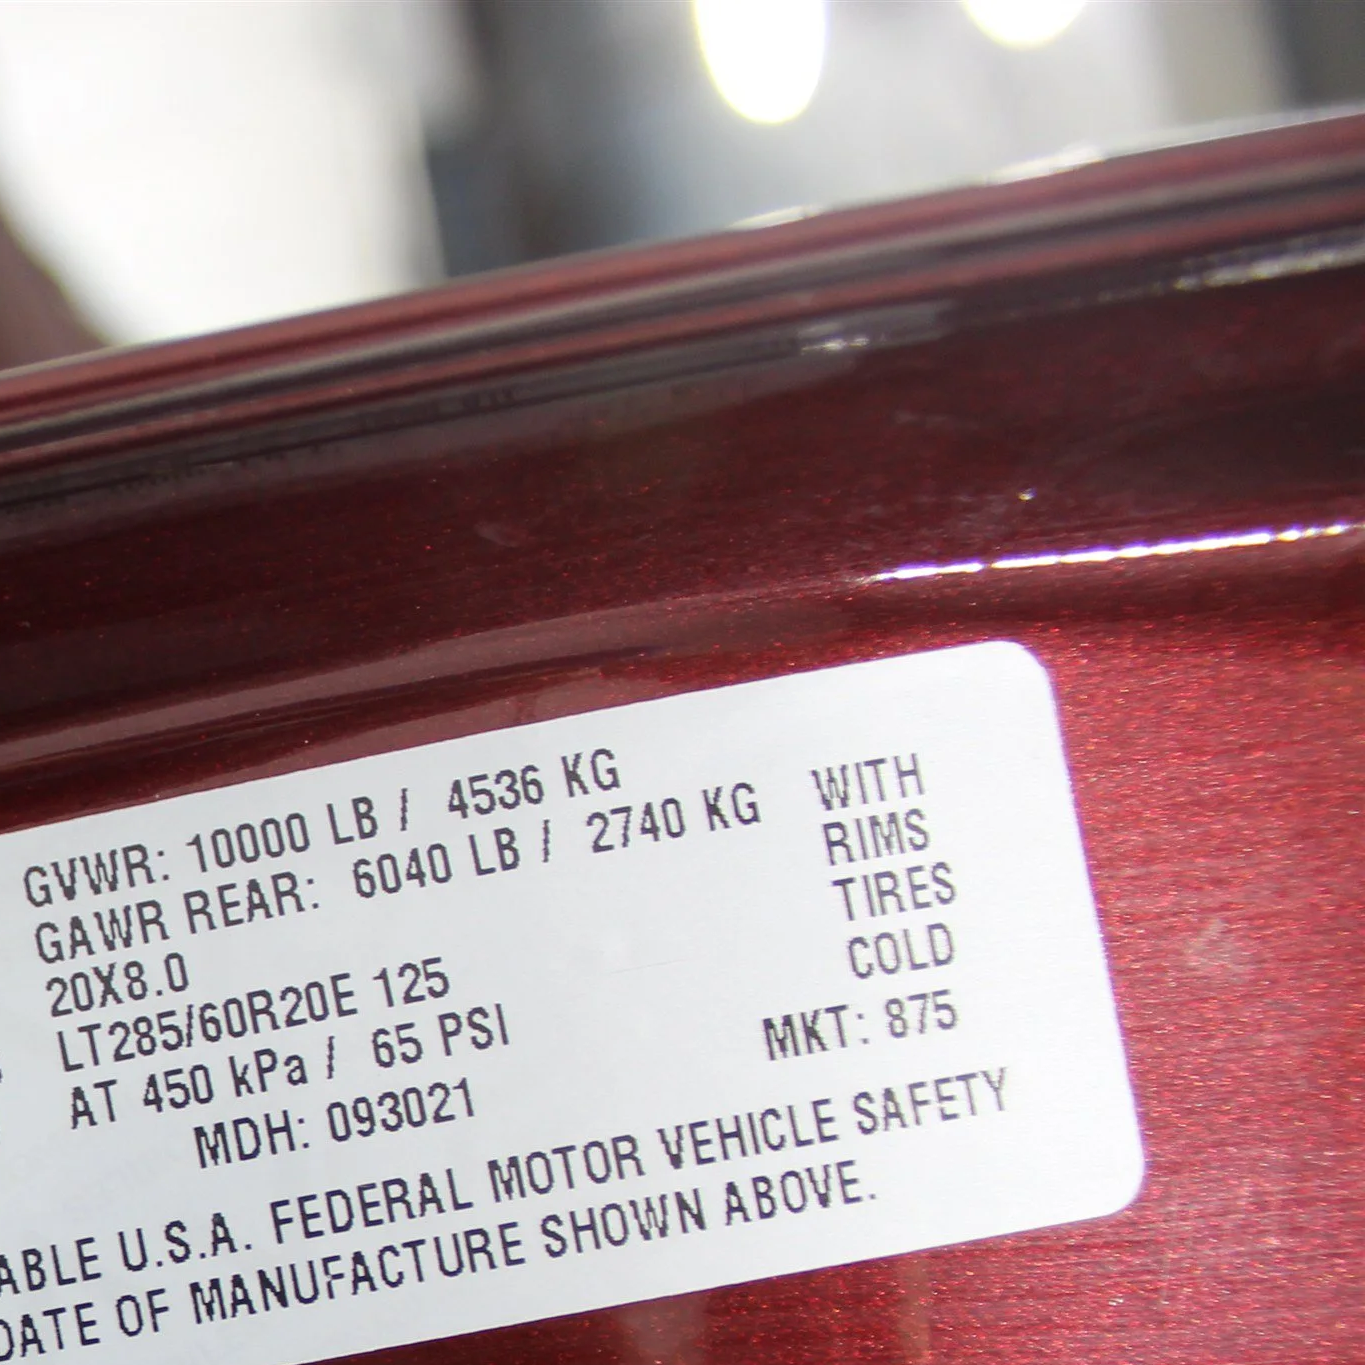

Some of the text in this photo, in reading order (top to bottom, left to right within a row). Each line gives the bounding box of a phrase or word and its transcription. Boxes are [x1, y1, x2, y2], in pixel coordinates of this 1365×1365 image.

[23, 844, 169, 907] GVWR:
[186, 813, 310, 872] 10000
[327, 796, 378, 845] LB
[448, 765, 544, 819] 4536
[561, 748, 621, 797] KG
[811, 754, 923, 811] WITH
[35, 900, 170, 964] GAWR
[183, 872, 319, 934] REAR:
[352, 843, 452, 898] 6040
[468, 827, 520, 876] LB
[586, 798, 686, 853] 2740
[702, 783, 761, 831] KG
[823, 809, 928, 866] RIMS
[832, 862, 955, 921] TIRES
[46, 952, 189, 1017] 20X8.0
[848, 923, 954, 979] COLD
[57, 957, 450, 1072] LT285/60R20E 125
[762, 989, 957, 1060] MKT: 875
[71, 1079, 117, 1130] AT
[143, 1064, 214, 1113] 450
[228, 1048, 308, 1097] kPa
[372, 1022, 423, 1068] 65
[437, 1003, 509, 1056] PSI
[193, 1077, 474, 1169] MDH: 093021
[118, 1212, 252, 1272] U.S.A.
[270, 1168, 474, 1244] FEDERAL
[487, 1135, 645, 1203] MOTOR
[657, 1099, 839, 1169] VEHICLE
[853, 1068, 1004, 1135] SAFETY
[115, 1288, 169, 1337] OF
[189, 1222, 526, 1324] MANUFACTURE
[540, 1188, 706, 1258] SHOWN
[725, 1160, 875, 1226] ABOVE.
